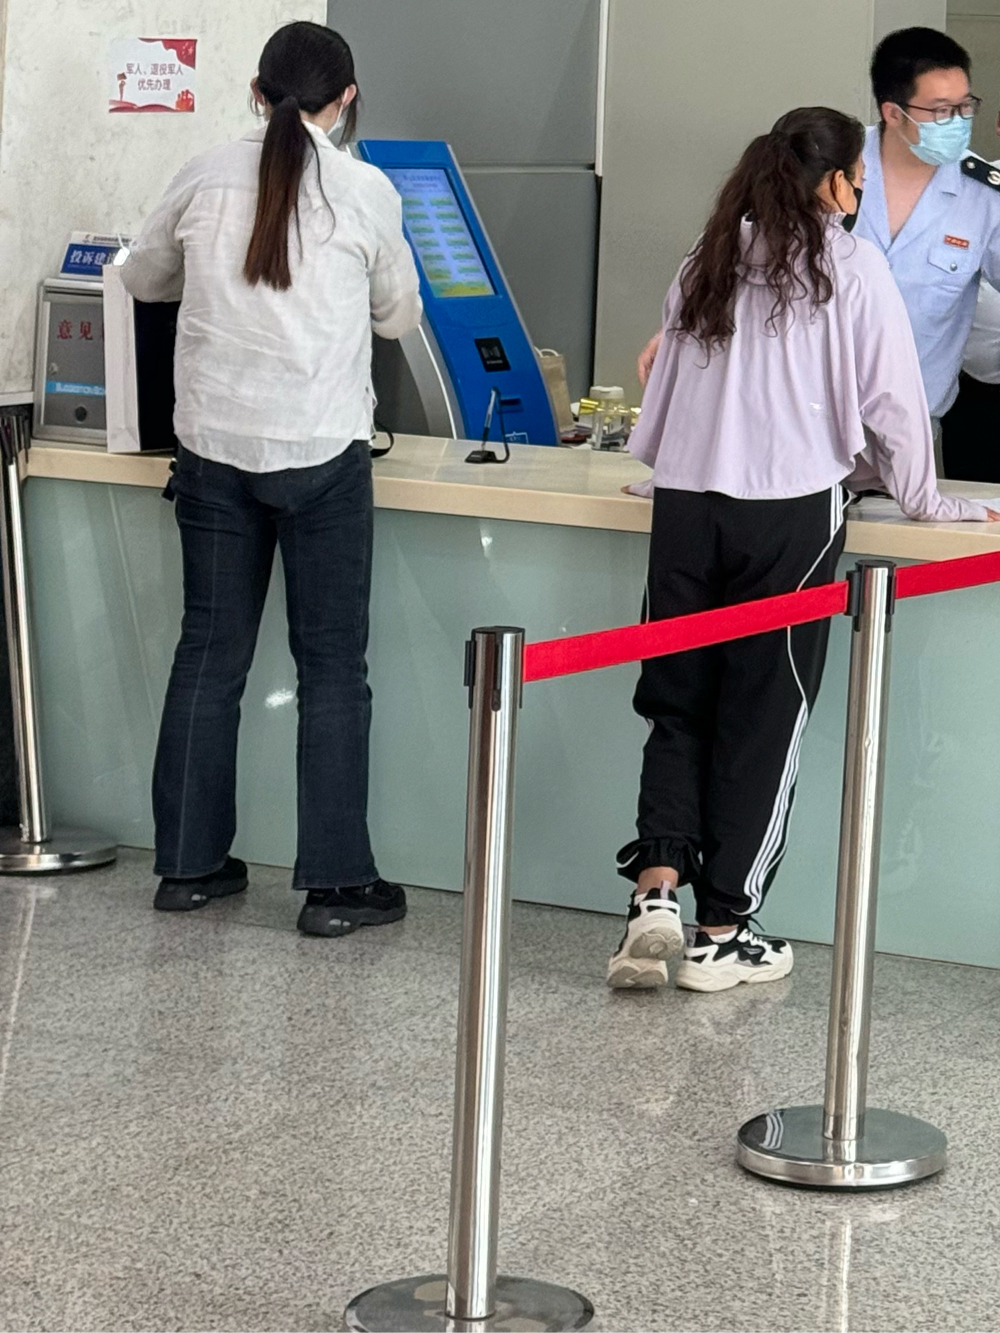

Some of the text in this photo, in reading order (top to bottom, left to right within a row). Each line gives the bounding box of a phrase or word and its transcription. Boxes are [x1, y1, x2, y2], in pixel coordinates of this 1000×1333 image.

[138, 79, 172, 91] 优先办理
[57, 319, 104, 341] 意见
